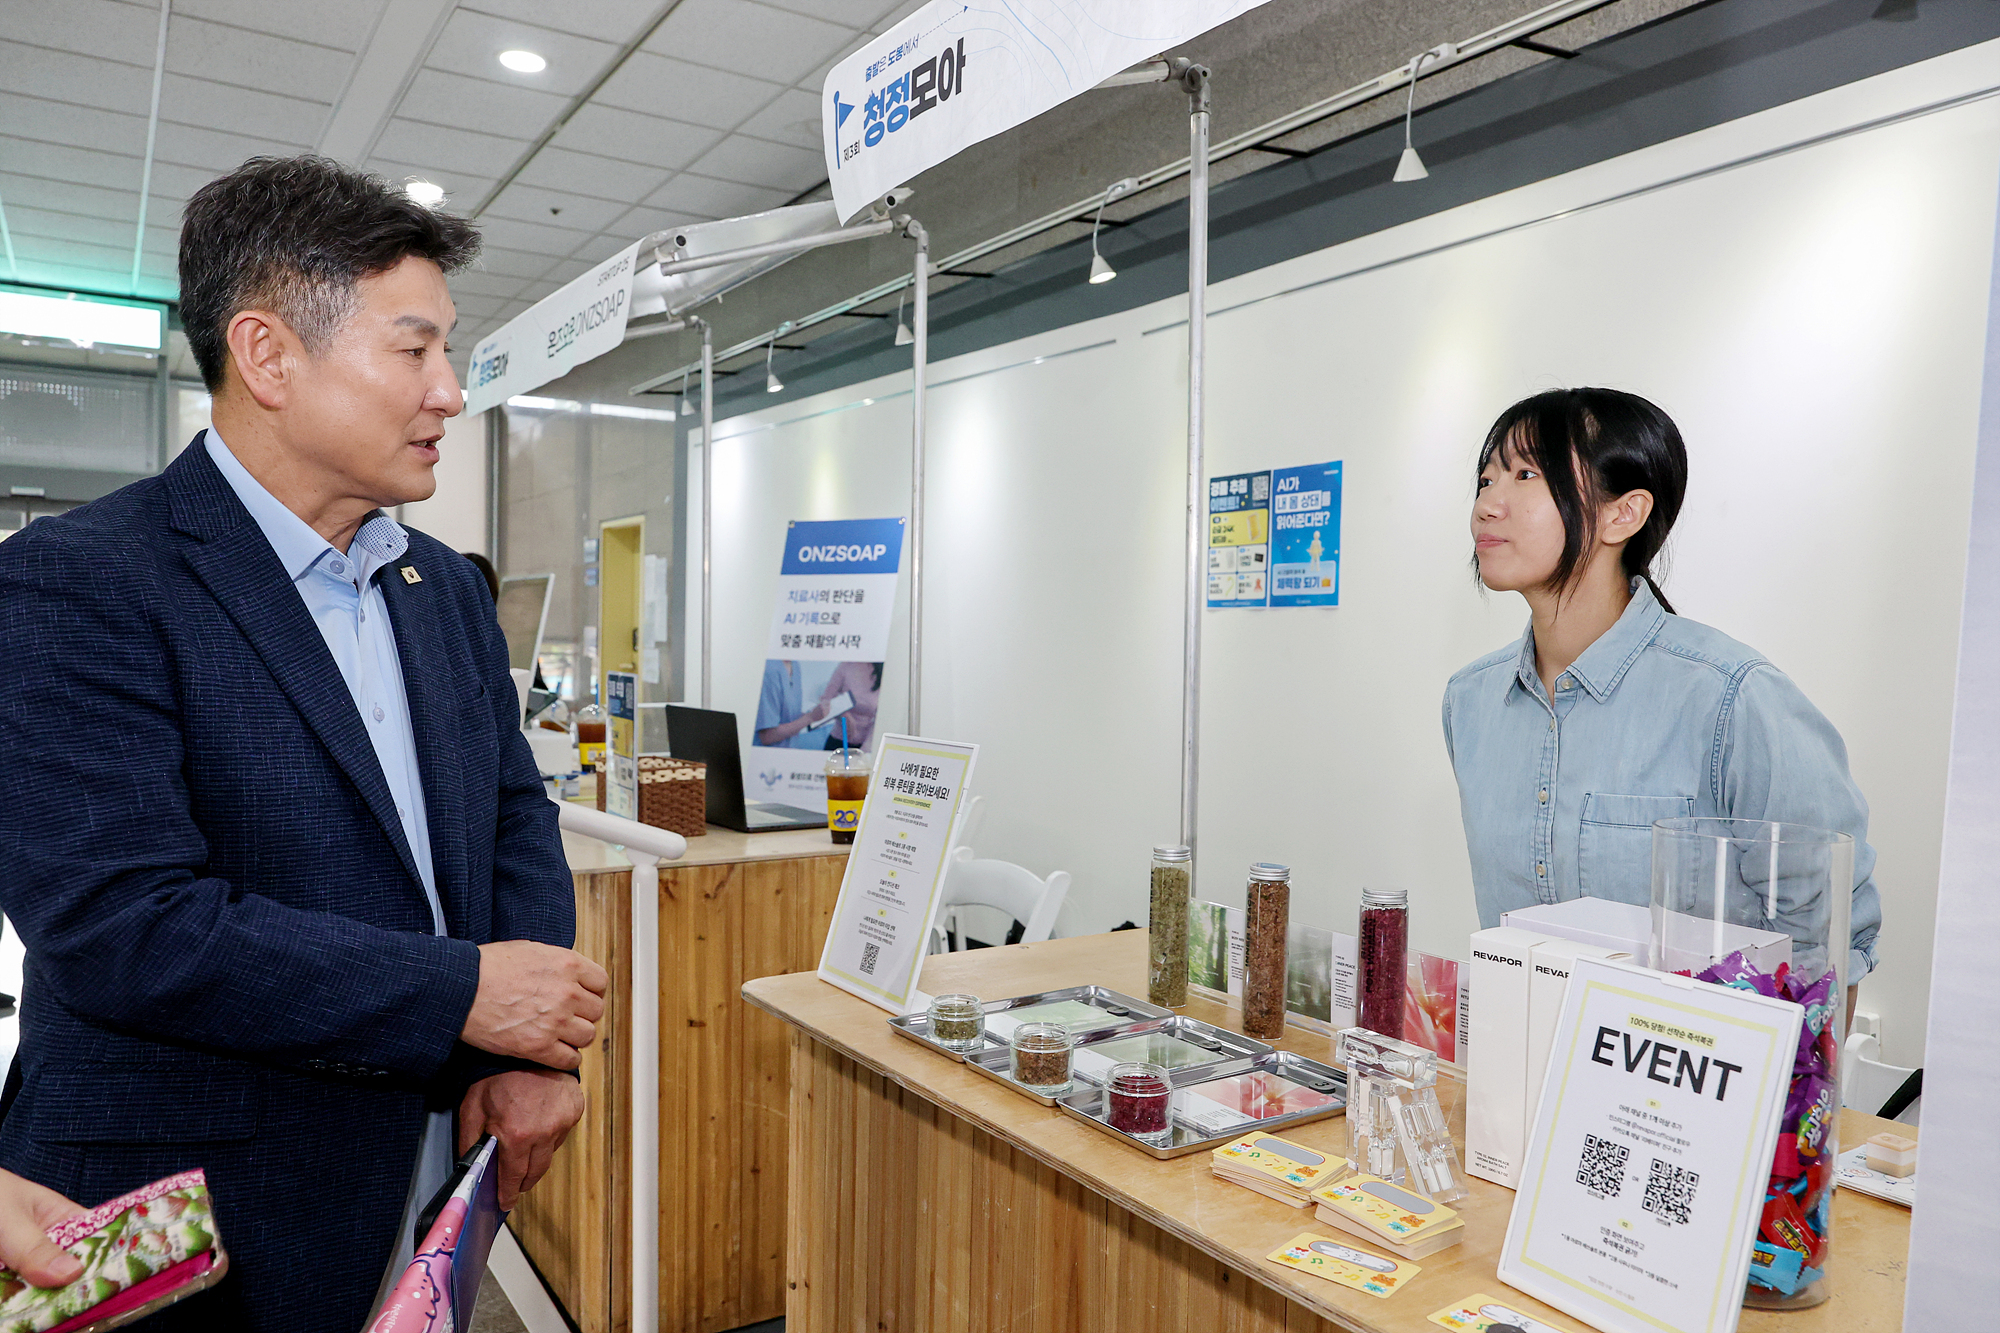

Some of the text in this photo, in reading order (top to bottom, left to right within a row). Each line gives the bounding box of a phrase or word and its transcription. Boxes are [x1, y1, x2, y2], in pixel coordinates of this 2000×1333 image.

[888, 33, 920, 66] 도봉에서
[864, 37, 966, 148] 청정모아
[843, 140, 860, 162] 제3회
[1277, 476, 1300, 492] AI가
[1278, 497, 1286, 510] 내
[1276, 511, 1330, 530] 읽어준다면?
[798, 544, 887, 562] ONZSOAP
[1303, 576, 1320, 588] 되기
[788, 589, 865, 604] 치료사의 판단을
[783, 612, 841, 625] AI 기록으로
[781, 634, 861, 648] 맞춤 재활의 시작
[900, 762, 940, 781] 나에게 필요한
[883, 777, 950, 800] 회복 루틴을 찾아보세요!
[835, 809, 857, 823] 20
[1473, 950, 1523, 967] REVAPOR
[1365, 969, 1374, 993] FOR
[1629, 1017, 1715, 1048] 100% 당첨! 선착순 즉석복권
[1591, 1025, 1743, 1102] EVENT
[1631, 1108, 1641, 1117] 채널
[1659, 1118, 1671, 1127] 이상
[1671, 1122, 1683, 1131] 추가
